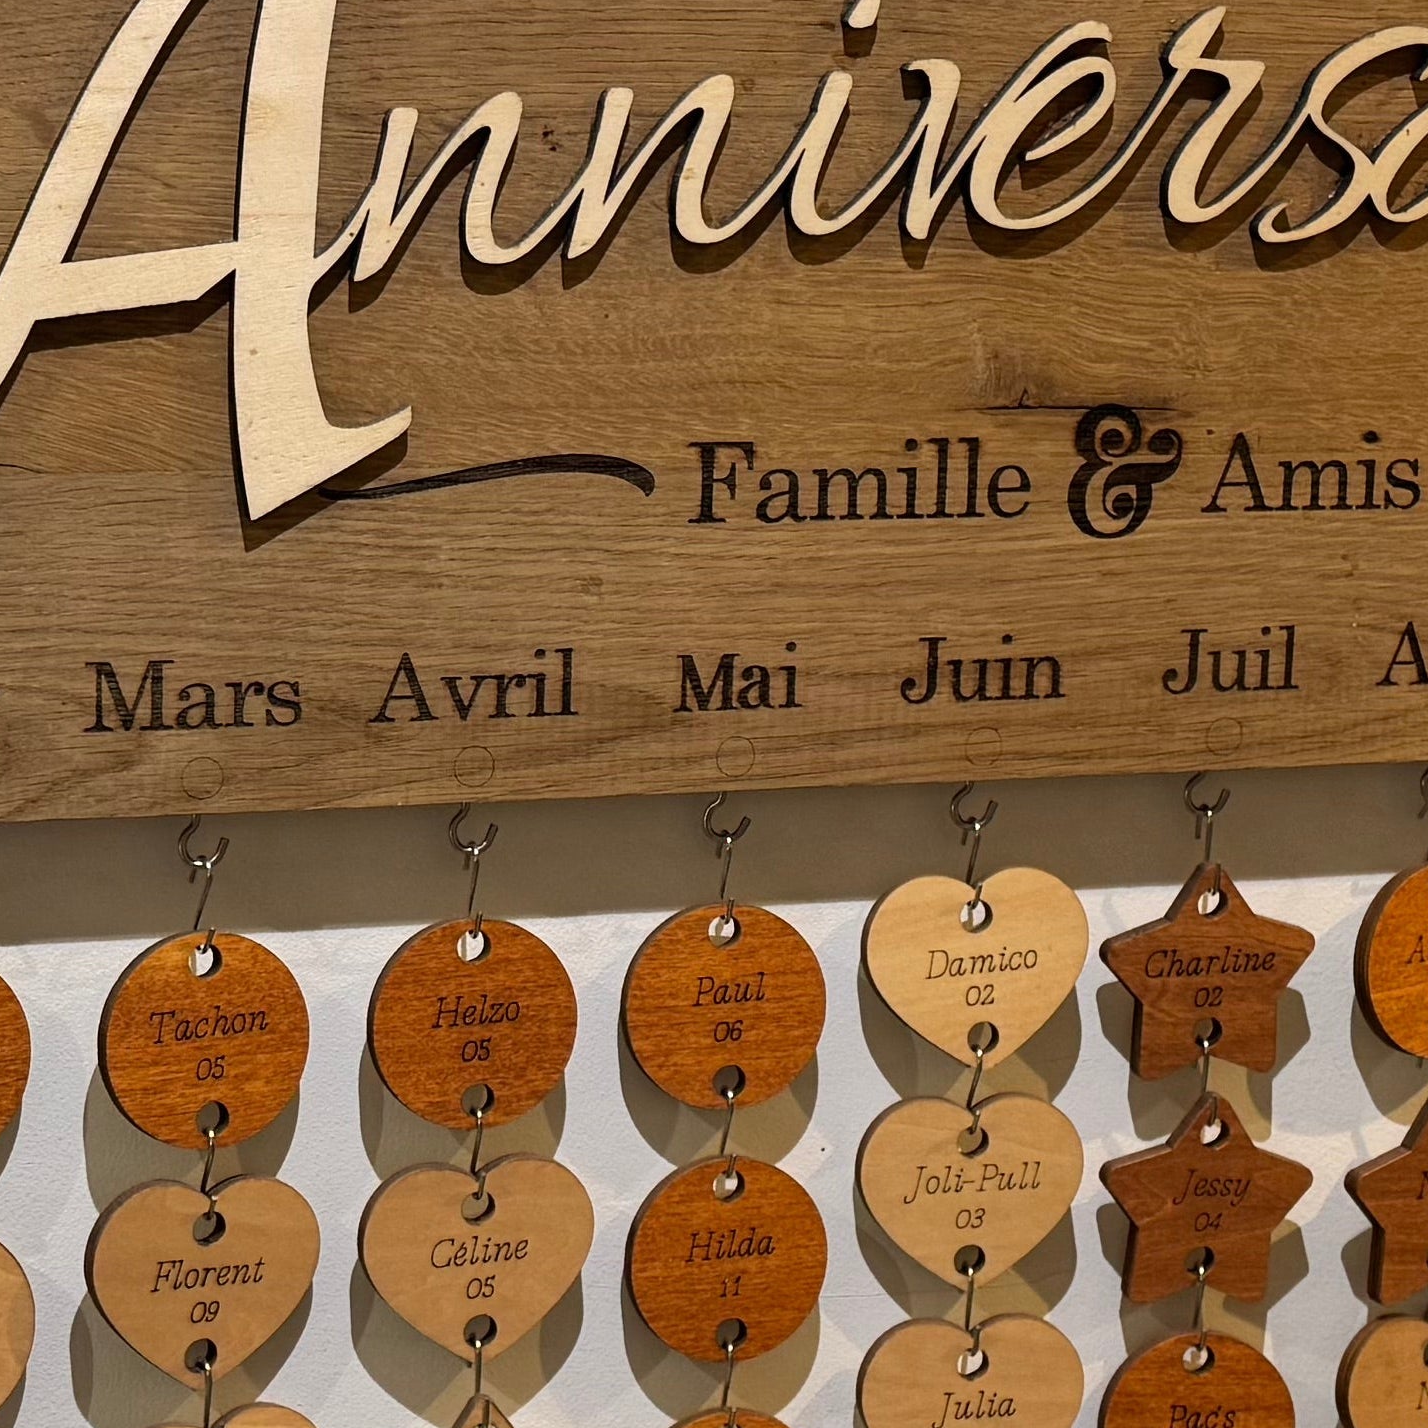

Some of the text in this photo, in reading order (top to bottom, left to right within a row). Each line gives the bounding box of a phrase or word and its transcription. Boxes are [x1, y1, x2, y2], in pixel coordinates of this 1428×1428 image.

[686, 405, 1421, 539] Famille & Amis
[82, 659, 304, 733] Mars
[372, 646, 578, 722] Avril
[673, 643, 802, 713] Mai
[900, 636, 1066, 706] Juin
[1161, 626, 1298, 697] Juil
[924, 946, 1040, 981] Damico
[1144, 947, 1276, 980] Charline
[692, 974, 766, 1008] Paul
[964, 984, 996, 1007] 02
[1194, 986, 1223, 1009] 02
[148, 1008, 270, 1045] Tachon
[713, 1020, 743, 1043] 06
[460, 1040, 492, 1062] 05
[195, 1056, 225, 1081] 05
[903, 1161, 1042, 1205] Joli-Pull
[1173, 1170, 1251, 1207] Jessy
[954, 1208, 985, 1230] 03
[1193, 1211, 1223, 1233] 04
[430, 1234, 530, 1270] Céline
[685, 1231, 776, 1264] Hilda
[149, 1258, 265, 1292] Florent
[466, 1276, 496, 1300] 05
[719, 1277, 742, 1298] 11
[190, 1300, 220, 1324] 09
